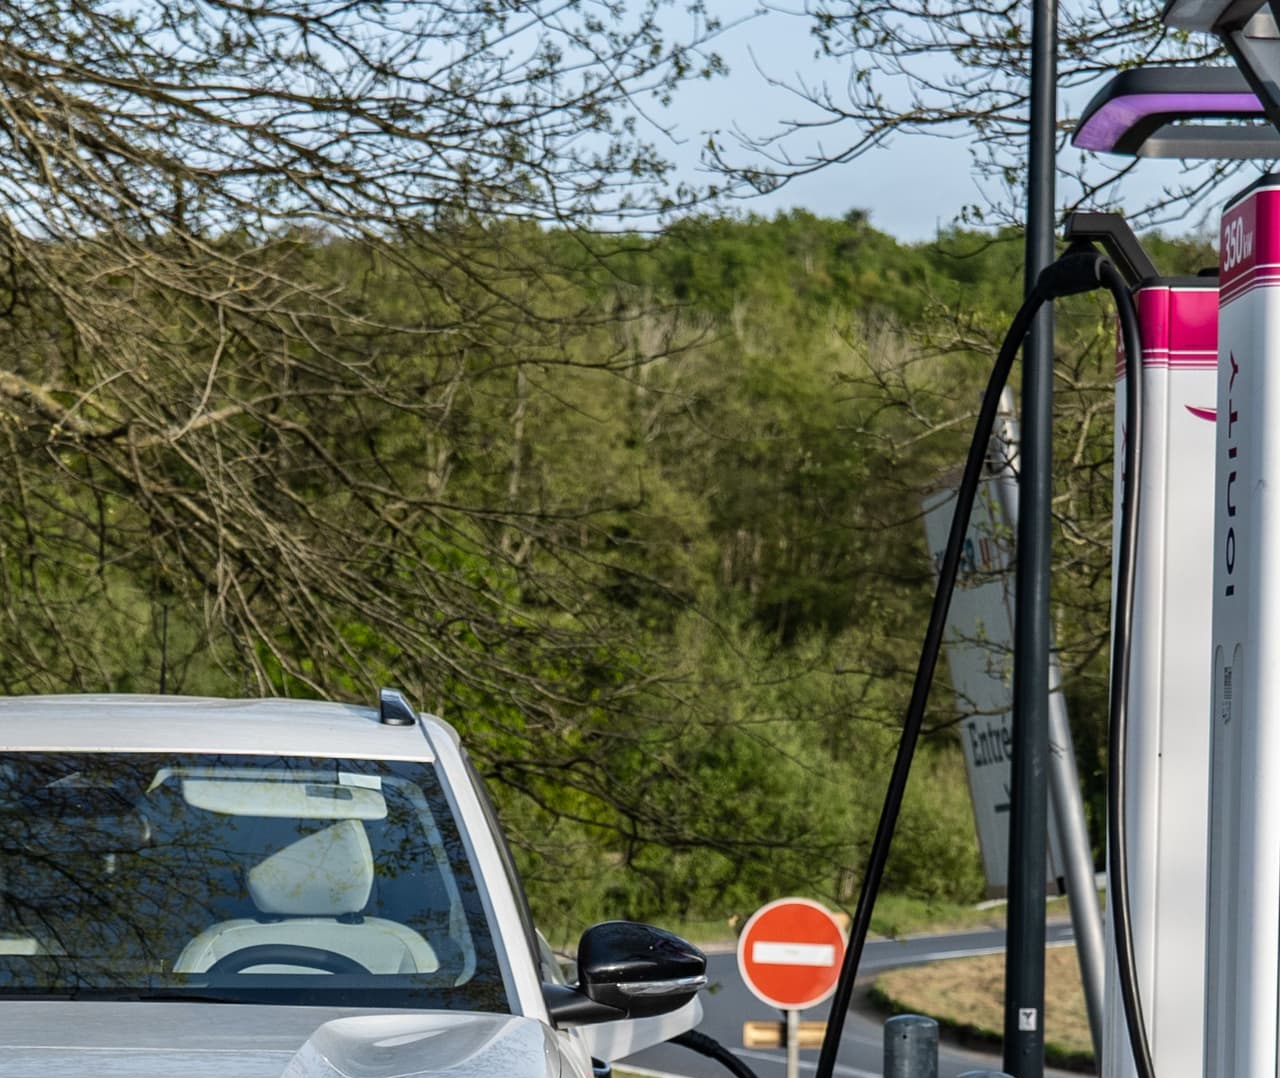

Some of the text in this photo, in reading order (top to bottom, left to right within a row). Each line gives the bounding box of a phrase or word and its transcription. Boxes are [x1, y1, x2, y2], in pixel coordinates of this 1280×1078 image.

[1223, 216, 1243, 272] 350
[1225, 349, 1239, 597] IONITY
[968, 714, 1013, 767] Entré
